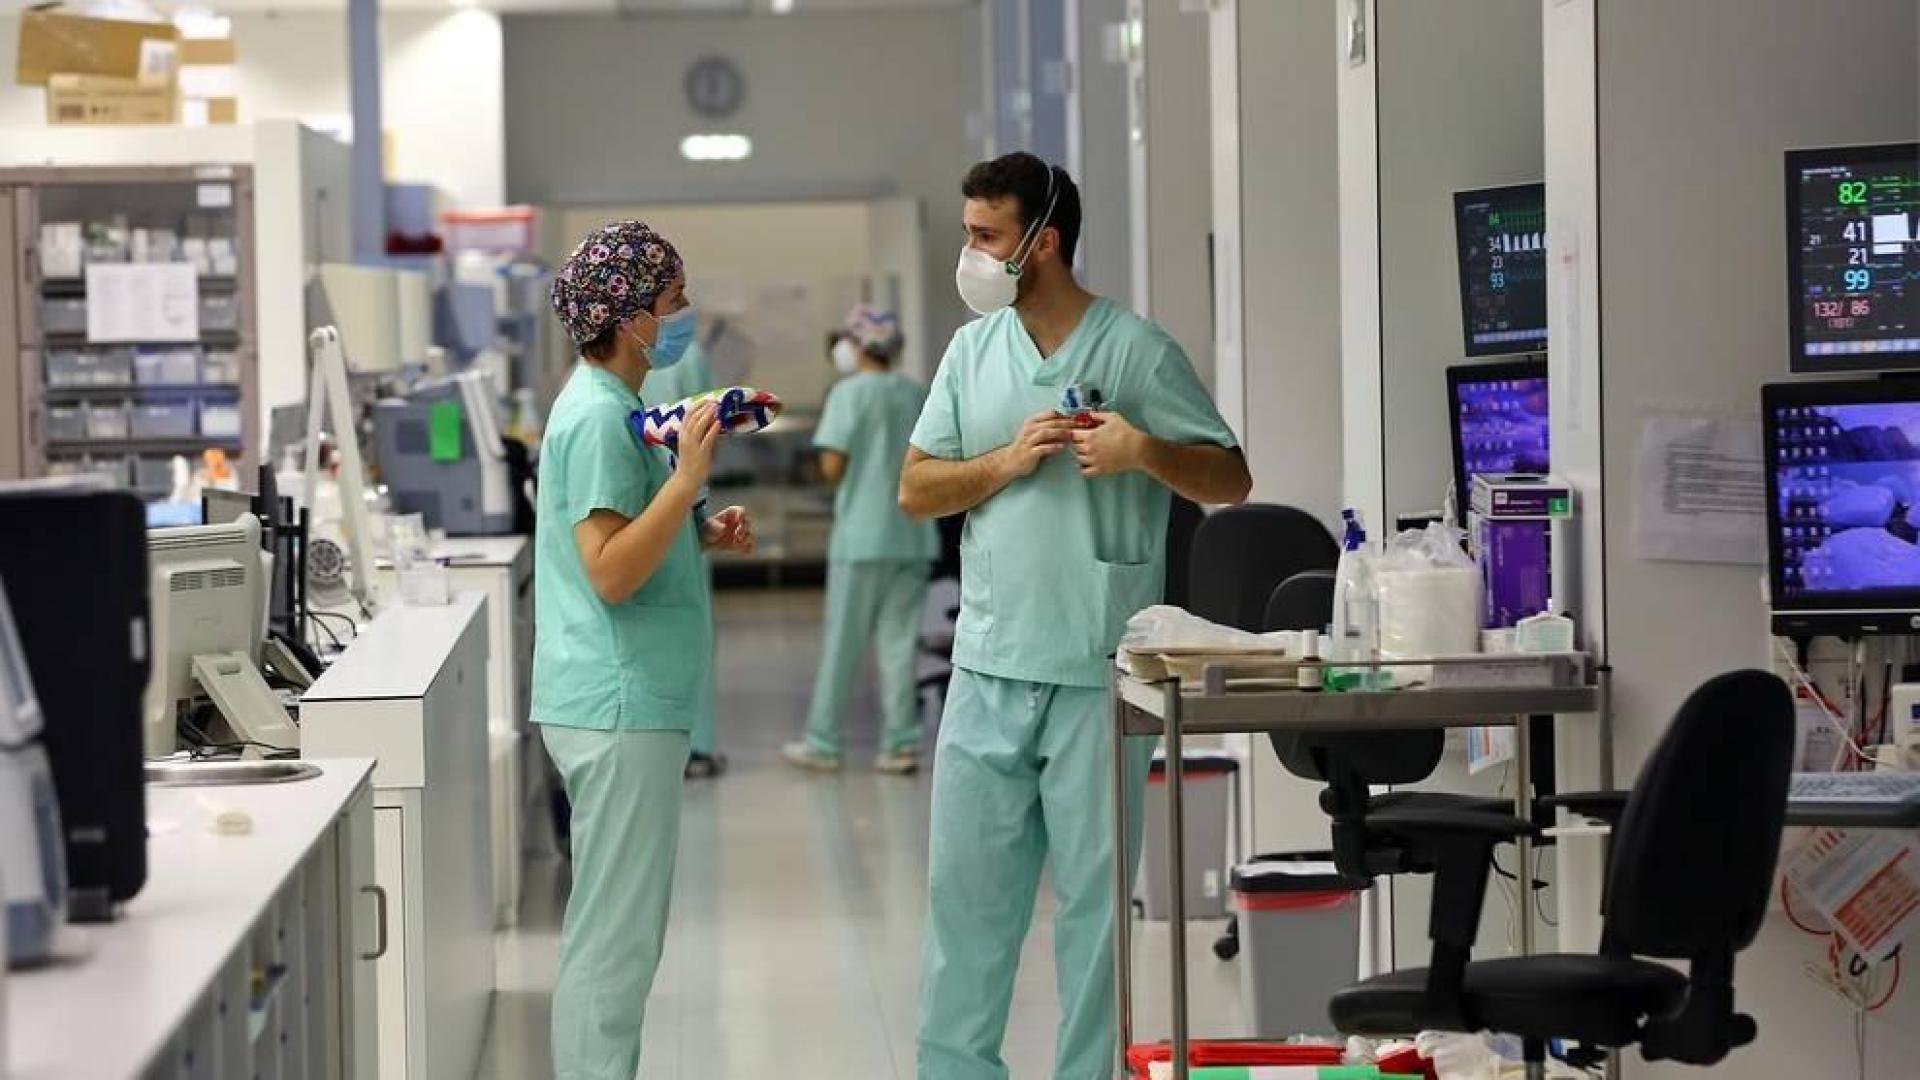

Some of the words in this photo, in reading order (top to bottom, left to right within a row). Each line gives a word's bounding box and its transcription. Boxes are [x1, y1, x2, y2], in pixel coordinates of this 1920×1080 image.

[1838, 182, 1867, 204] 82
[1843, 222, 1865, 242] 41
[1849, 248, 1866, 264] 21
[1845, 269, 1869, 290] 99
